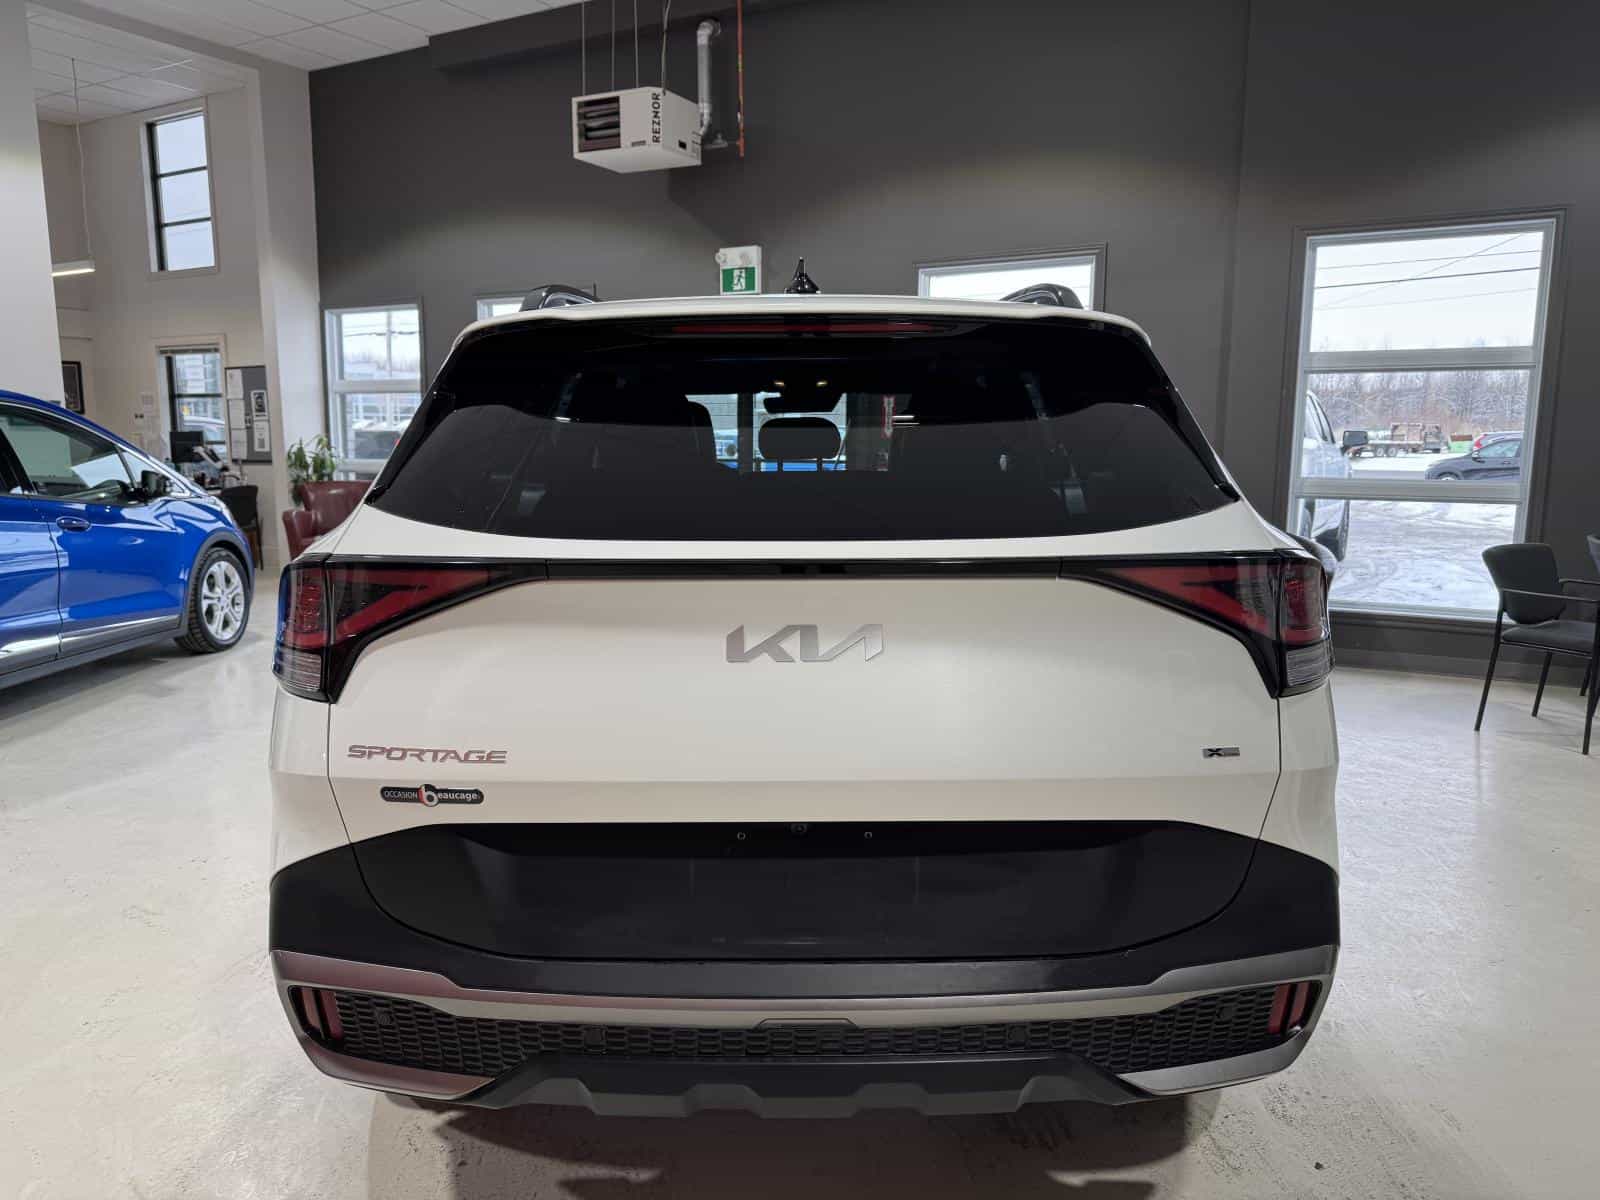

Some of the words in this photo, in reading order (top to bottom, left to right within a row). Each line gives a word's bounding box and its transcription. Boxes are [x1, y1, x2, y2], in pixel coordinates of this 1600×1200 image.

[652, 92, 661, 143] REZNOR
[726, 624, 884, 663] KIA
[347, 744, 508, 764] SPORTAGE
[383, 790, 418, 800] OCCASION
